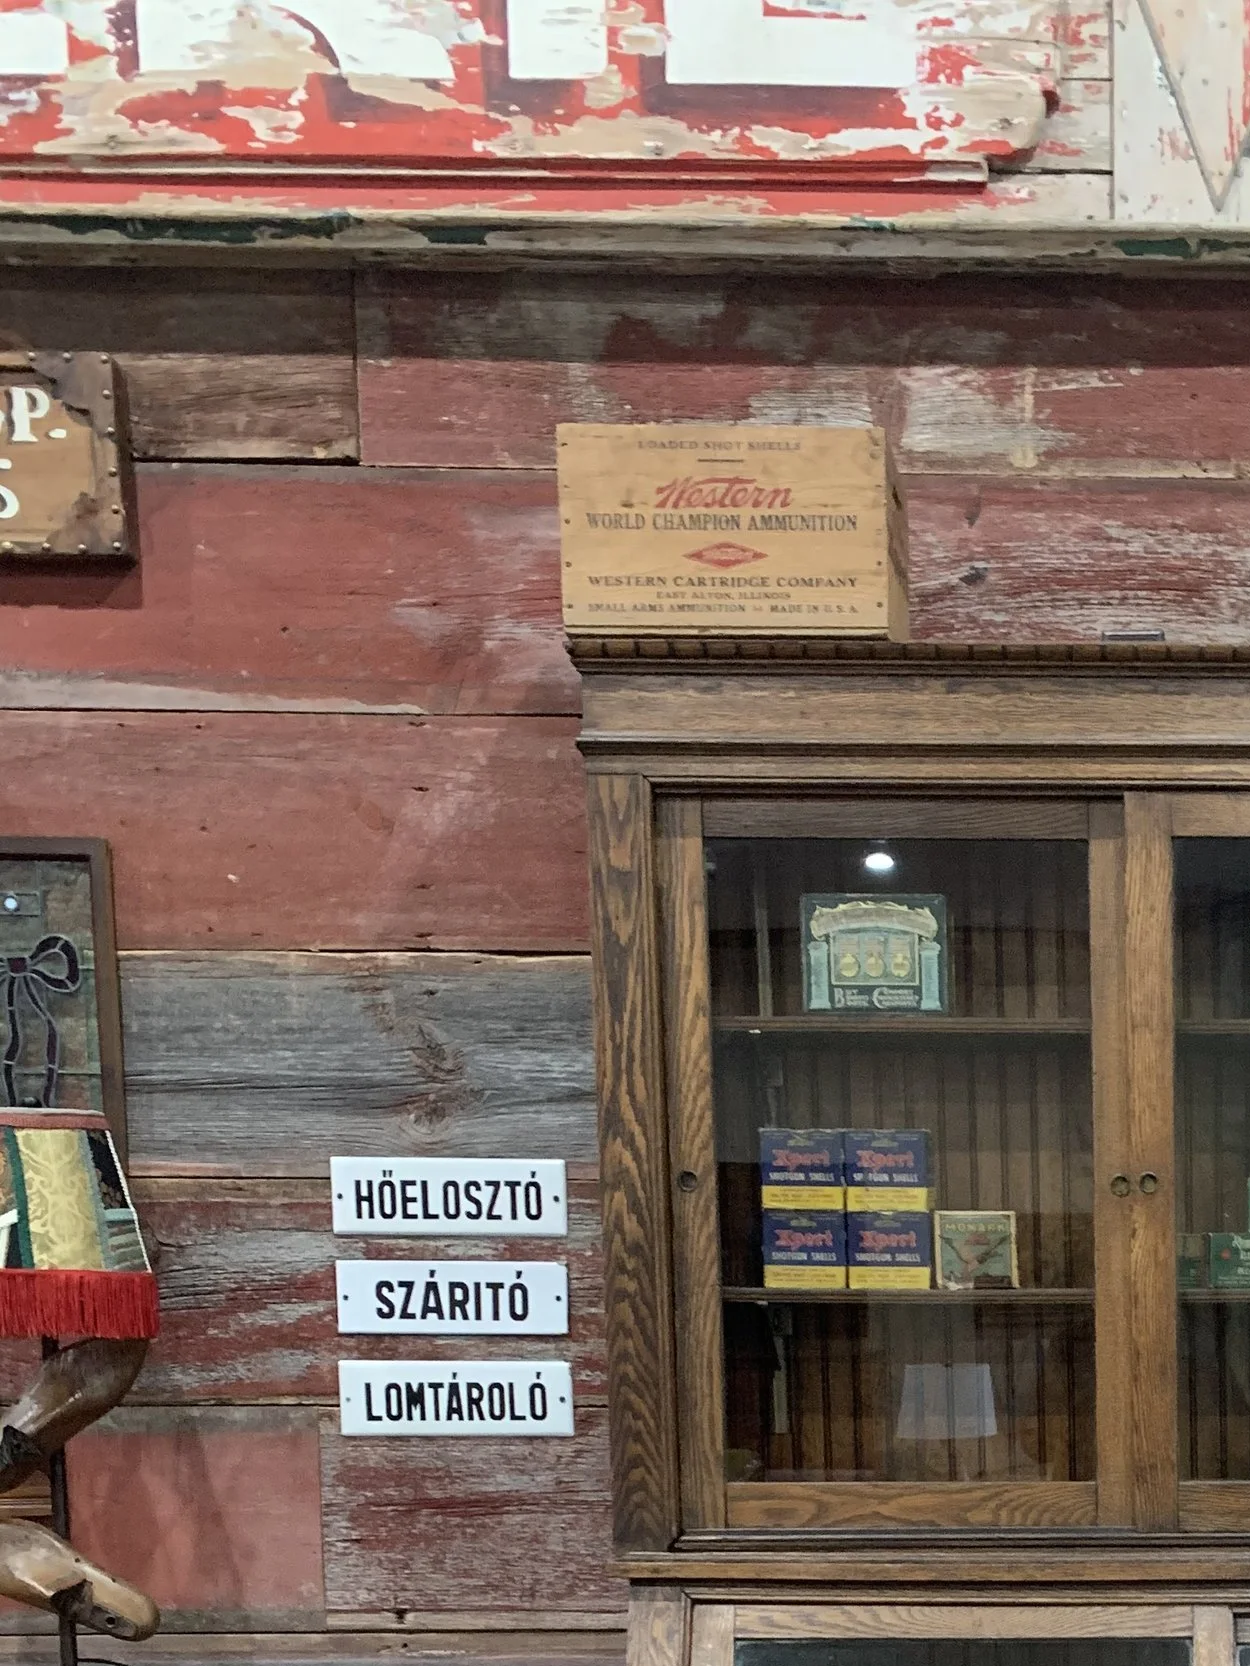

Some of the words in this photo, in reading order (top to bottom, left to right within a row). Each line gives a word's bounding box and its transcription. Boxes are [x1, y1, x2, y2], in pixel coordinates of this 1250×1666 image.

[638, 440, 698, 450] LOADED
[703, 440, 742, 451] SHOT
[748, 441, 801, 451] SHELLS
[654, 475, 793, 510] Western
[585, 512, 646, 531] WORLD
[652, 513, 742, 531] CHAMPION
[747, 514, 858, 532] AMMUNITION
[588, 576, 667, 588] WESTERN
[673, 576, 771, 588] CARTRIDGE
[776, 576, 859, 589] COMPANY
[656, 591, 687, 600] EAST
[738, 591, 792, 601] ILLINOIS
[588, 603, 627, 613] SMALL
[631, 603, 665, 613] ARMS
[669, 603, 746, 614] AMMUNITION
[769, 604, 802, 614] MADE
[375, 1269, 530, 1322] SZÁRITÓ
[364, 1371, 548, 1422] LOMTÁROLÓ
